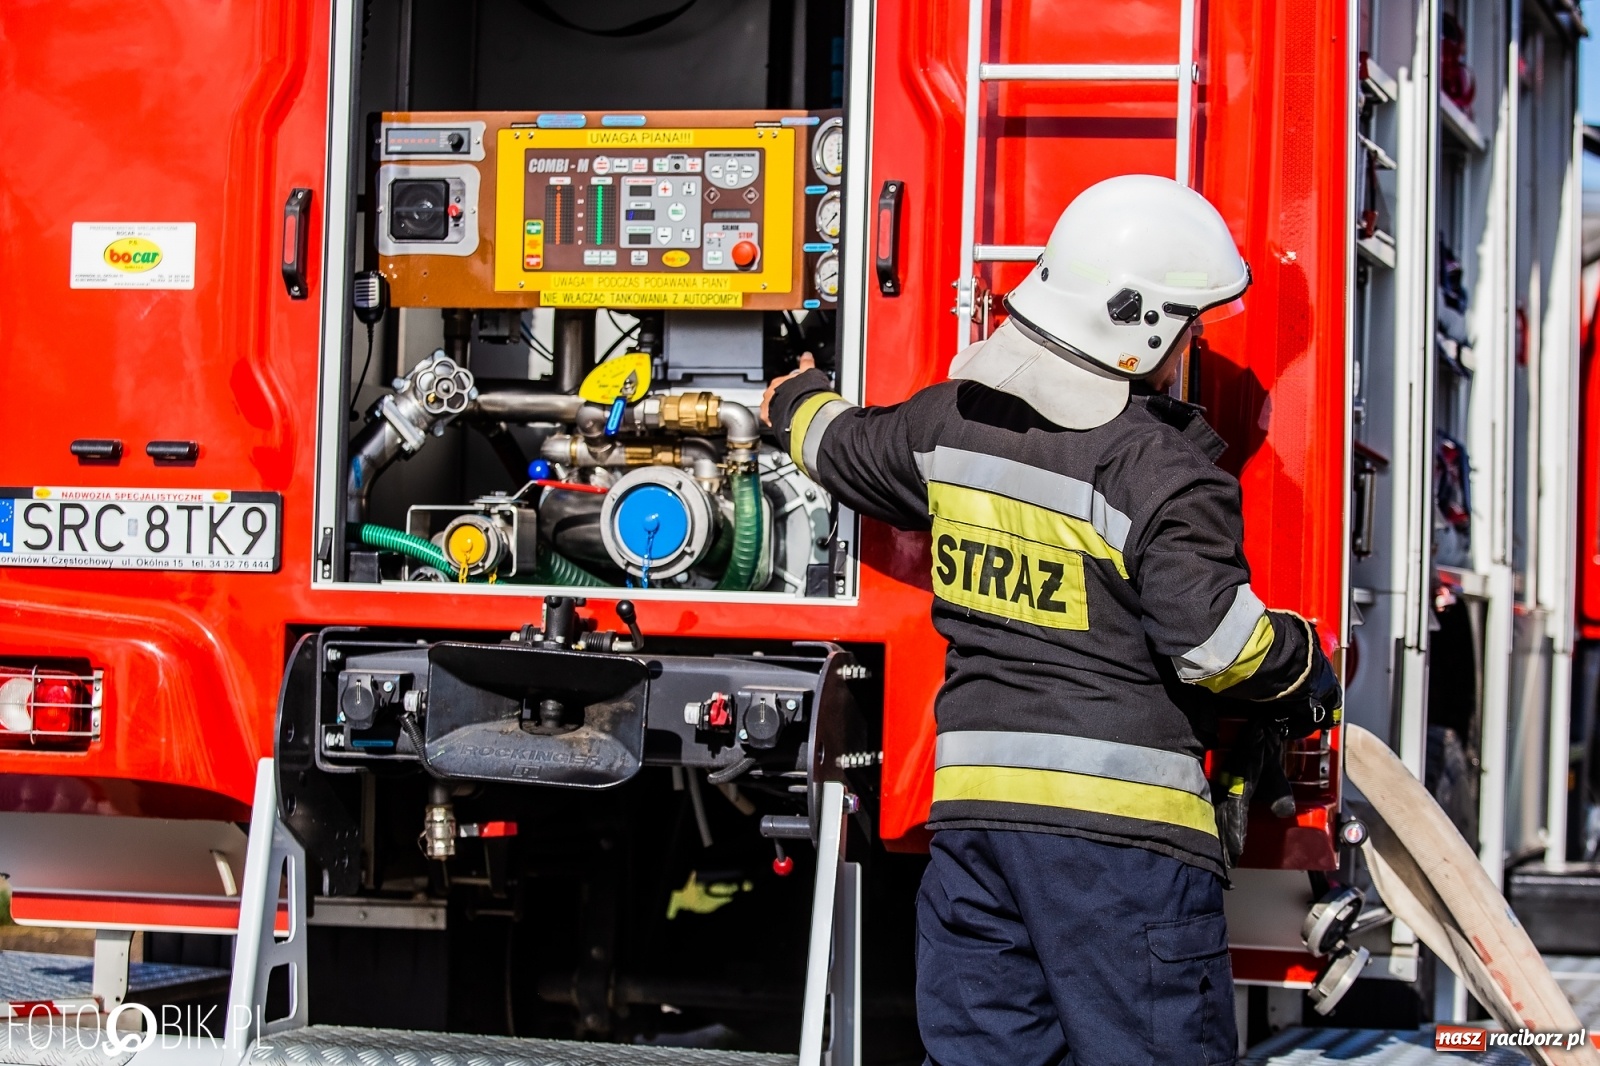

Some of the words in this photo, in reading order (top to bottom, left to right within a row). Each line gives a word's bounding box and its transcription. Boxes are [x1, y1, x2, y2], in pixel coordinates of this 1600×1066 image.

[590, 132, 638, 144] UWAGA
[641, 132, 691, 144] PIANA!!!
[109, 249, 160, 264] bocar
[598, 276, 640, 288] PODCZAS
[644, 276, 697, 288] PODAWANIA
[702, 276, 729, 288] PIANY
[543, 293, 557, 304] NIE
[610, 293, 668, 304] TANKOWANIA
[672, 294, 679, 304] Z
[683, 293, 739, 305] AUTOPOMPY
[61, 491, 111, 501] NADWOZIA
[115, 492, 204, 502] SPECJALISTYCZNE
[23, 502, 126, 552] SRC
[145, 504, 268, 556] 8TK9
[121, 558, 133, 567] ul.
[136, 559, 170, 568] Okólna
[173, 559, 184, 568] 15
[209, 560, 221, 568] 34
[224, 560, 235, 568] 32
[238, 561, 250, 569] 76
[252, 561, 270, 569] 444
[460, 744, 604, 768] ROCKINGER
